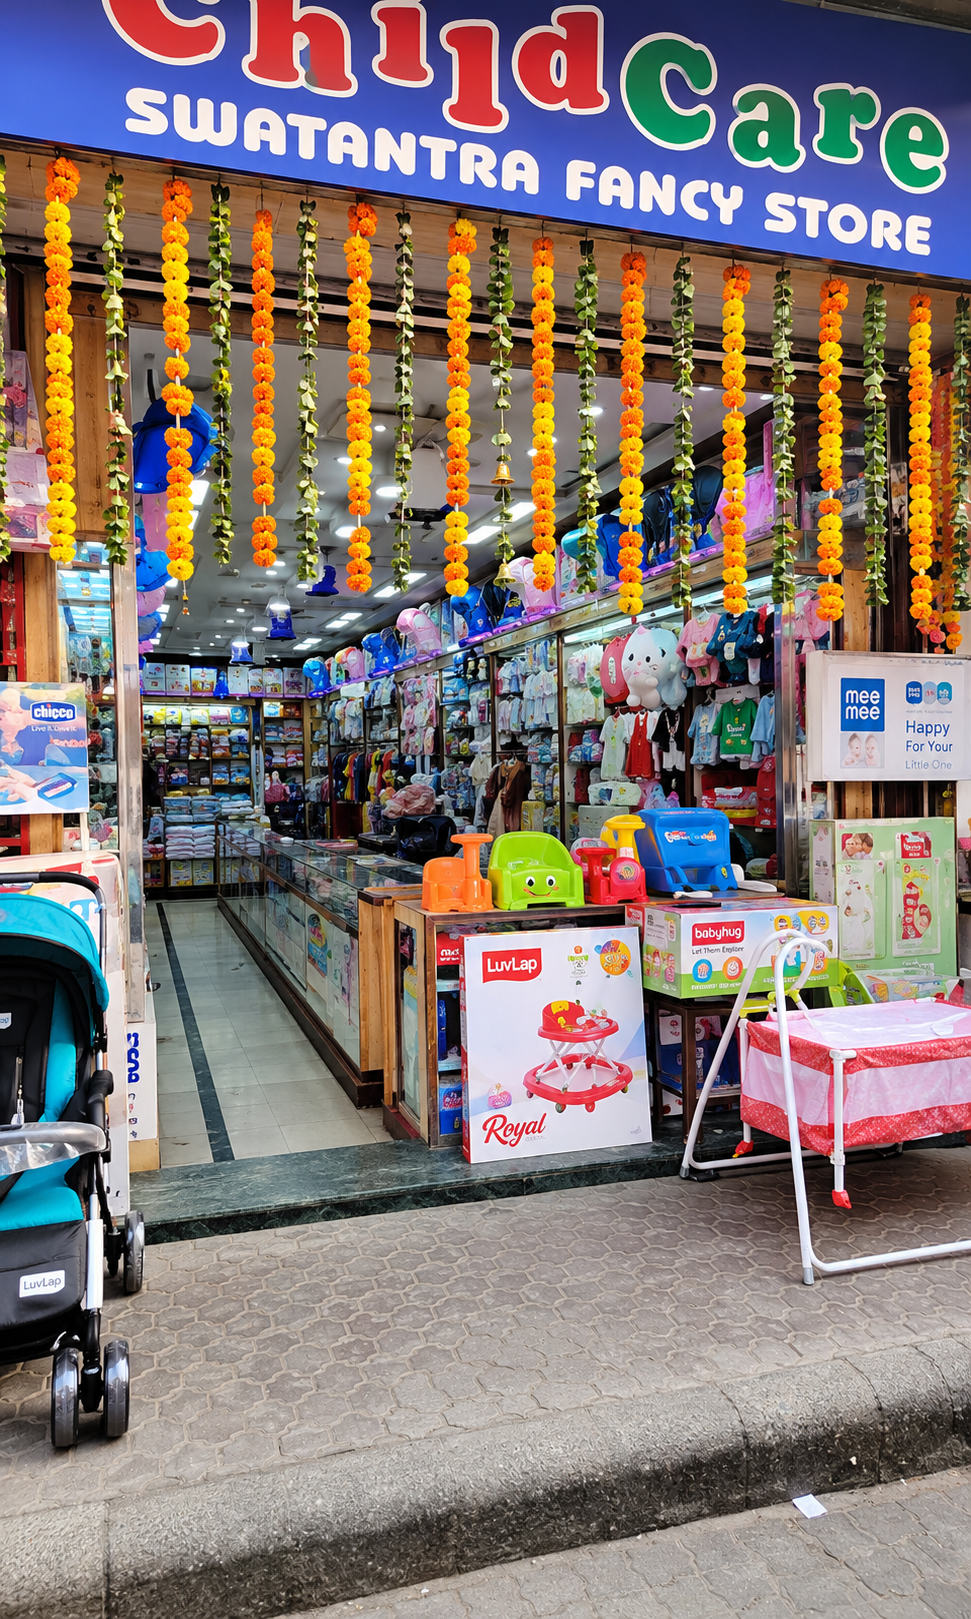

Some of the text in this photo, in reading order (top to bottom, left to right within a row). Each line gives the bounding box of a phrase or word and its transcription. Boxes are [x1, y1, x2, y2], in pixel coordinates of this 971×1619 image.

[125, 87, 932, 256] SWATANTRA FANCY STORE
[845, 690, 880, 704] mee
[845, 706, 880, 720] mee
[906, 720, 950, 737] Happy
[905, 740, 953, 752] For Your
[905, 759, 953, 770] Little One
[694, 926, 742, 941] babyhug
[486, 957, 538, 974] LuvLap
[482, 1112, 546, 1147] Royal
[23, 1277, 62, 1289] LuvLap
